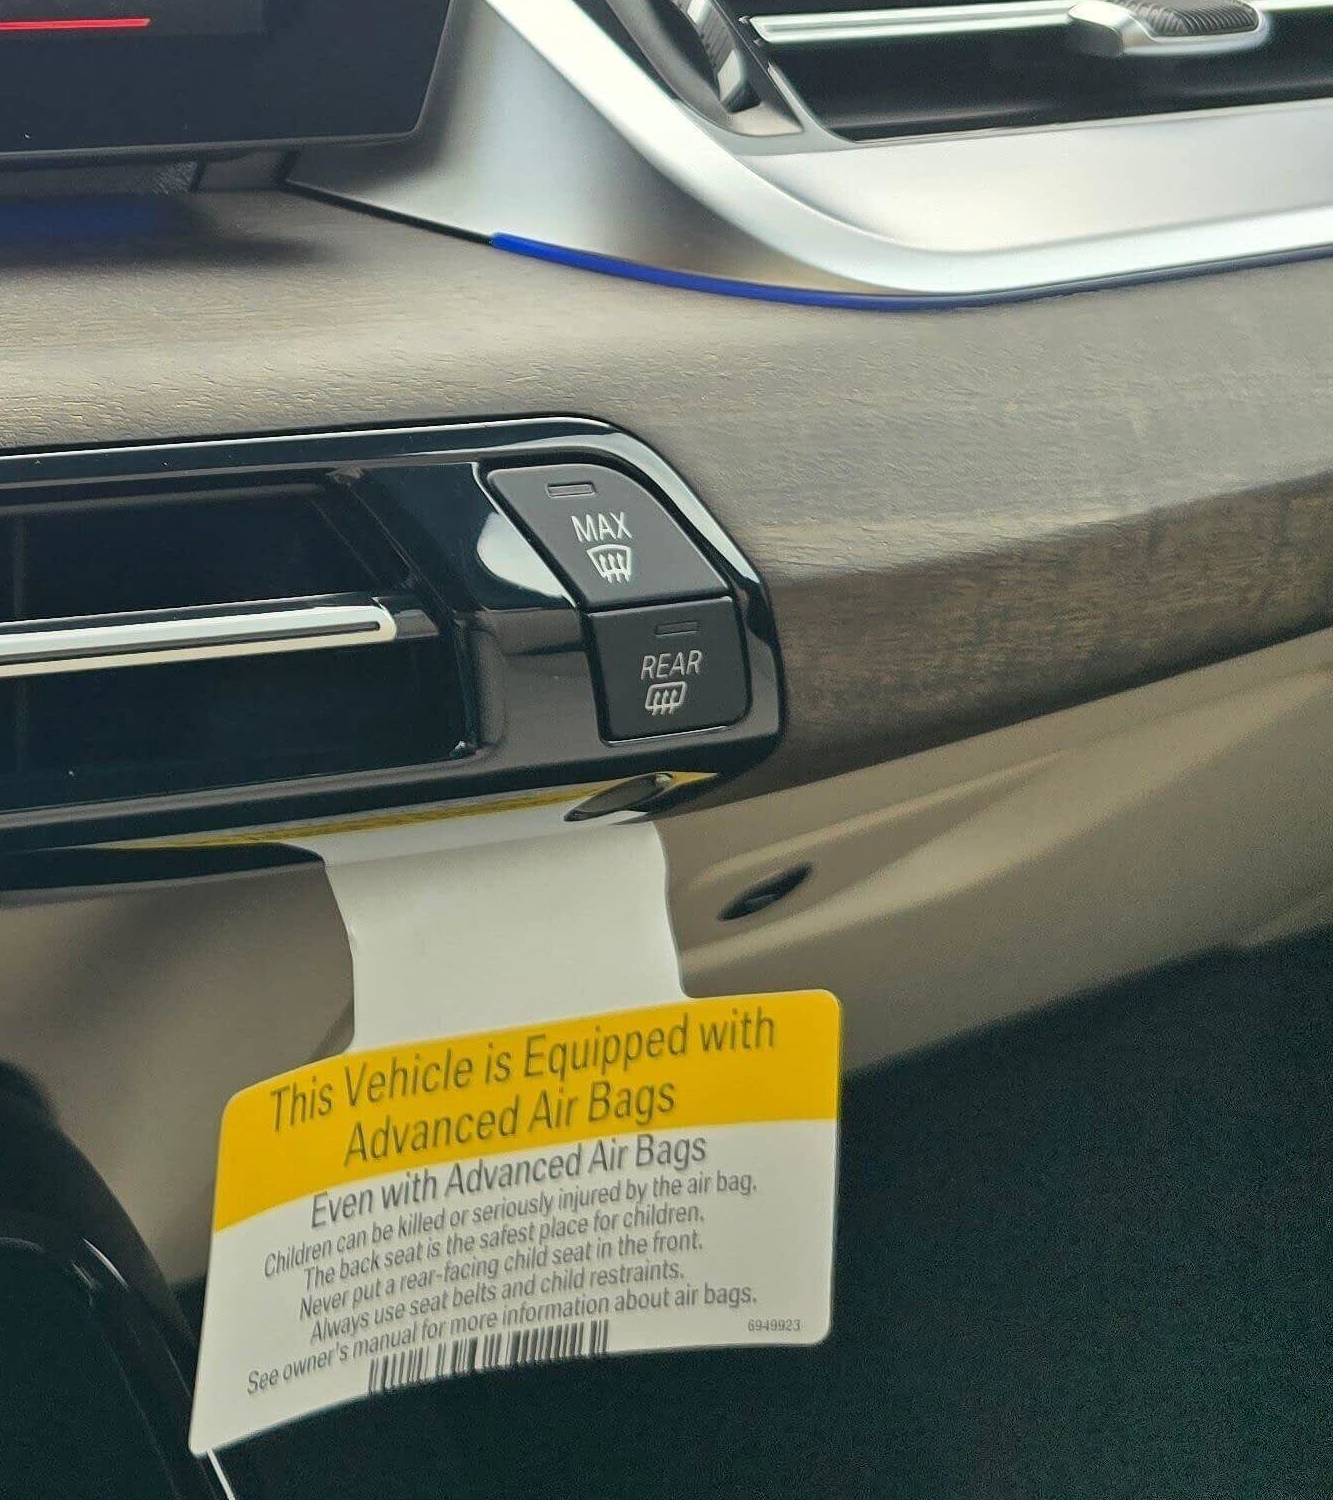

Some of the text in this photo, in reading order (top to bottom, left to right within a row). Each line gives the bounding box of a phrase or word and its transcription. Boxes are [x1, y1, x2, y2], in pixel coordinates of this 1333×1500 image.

[570, 511, 633, 543] MAX
[640, 649, 703, 681] REAR
[270, 1006, 775, 1133] This Vehicle is Equipped with
[343, 1080, 676, 1167] Advanced Air Bags
[263, 1170, 757, 1278] Children can be killed or seriously injured by the air bag.
[310, 1133, 707, 1229] Even with Advanced Air Bags
[299, 1228, 703, 1321] Never put a rear-facing child seat in the front.
[304, 1201, 705, 1292] The back seat is the safest place for children.
[247, 1282, 758, 1397] See owner's manual for more information about air bags.
[309, 1260, 684, 1346] Always use seat belts and child restraints.
[747, 1318, 802, 1333] 6949923
